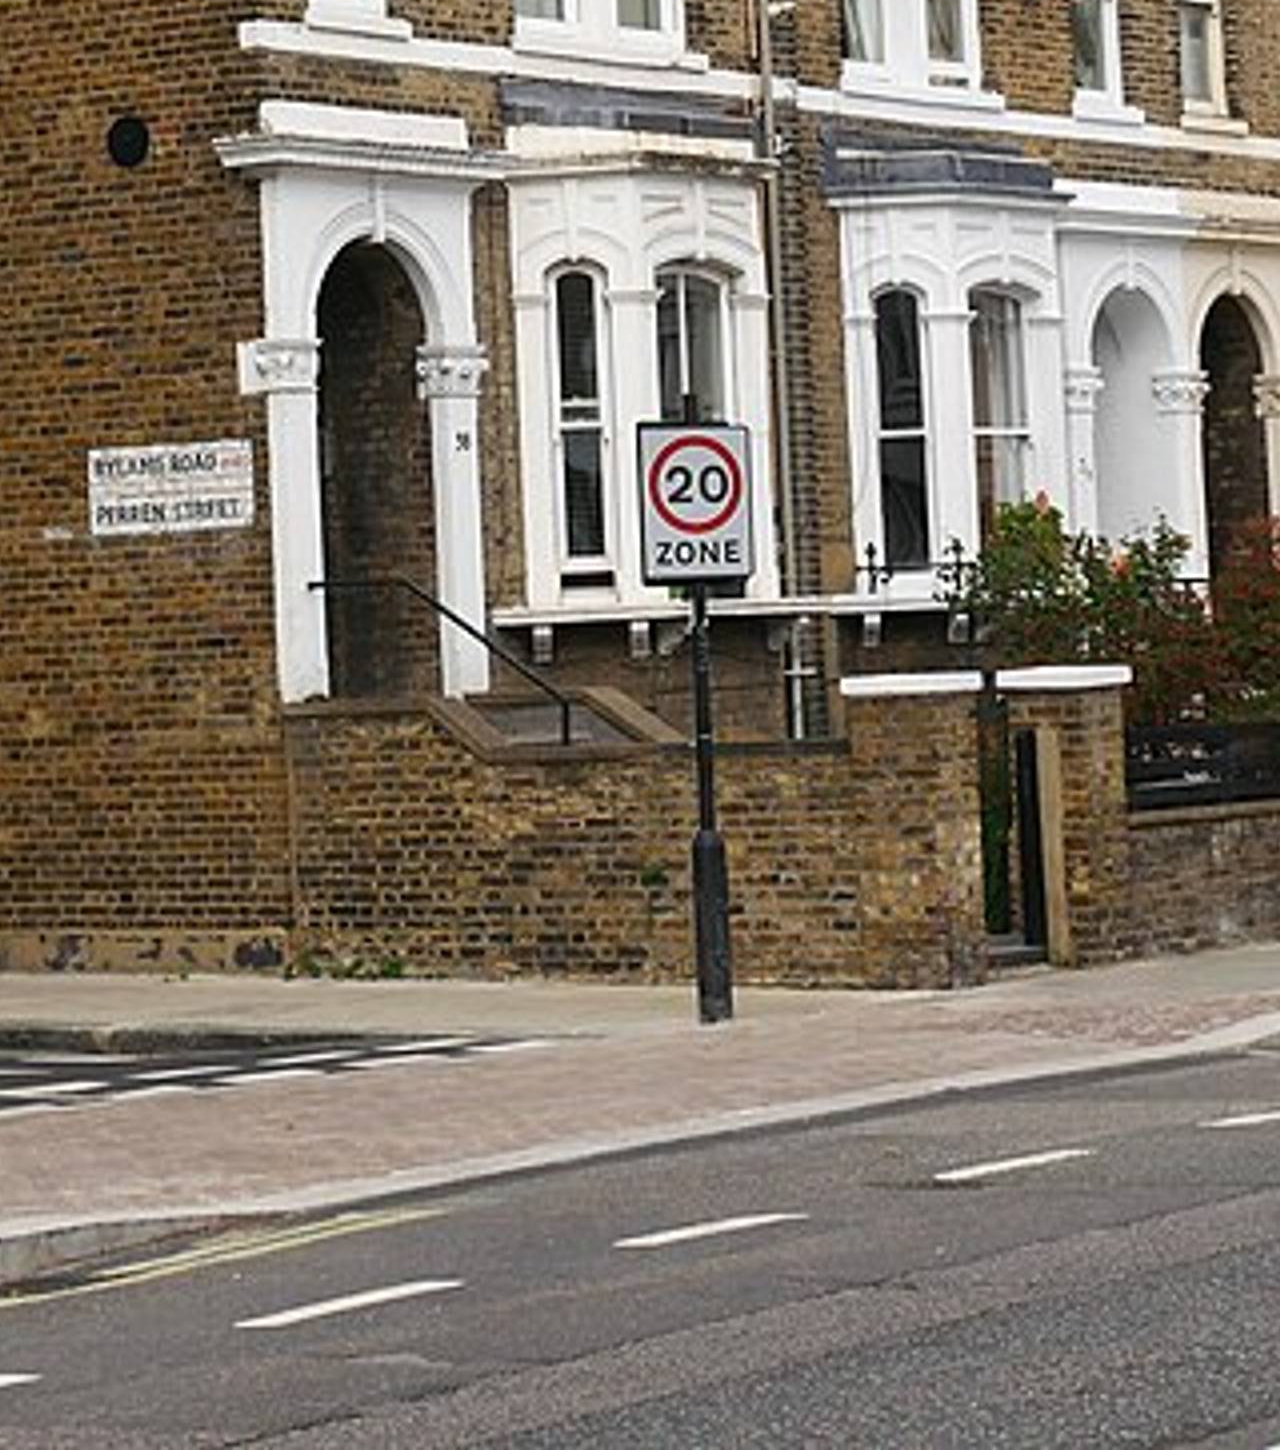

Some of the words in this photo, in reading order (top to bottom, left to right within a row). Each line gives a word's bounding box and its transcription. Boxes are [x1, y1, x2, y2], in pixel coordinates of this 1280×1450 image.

[172, 451, 217, 474] ROAD
[665, 465, 729, 503] 20
[176, 498, 241, 523] STREET
[656, 538, 741, 566] ZONE
